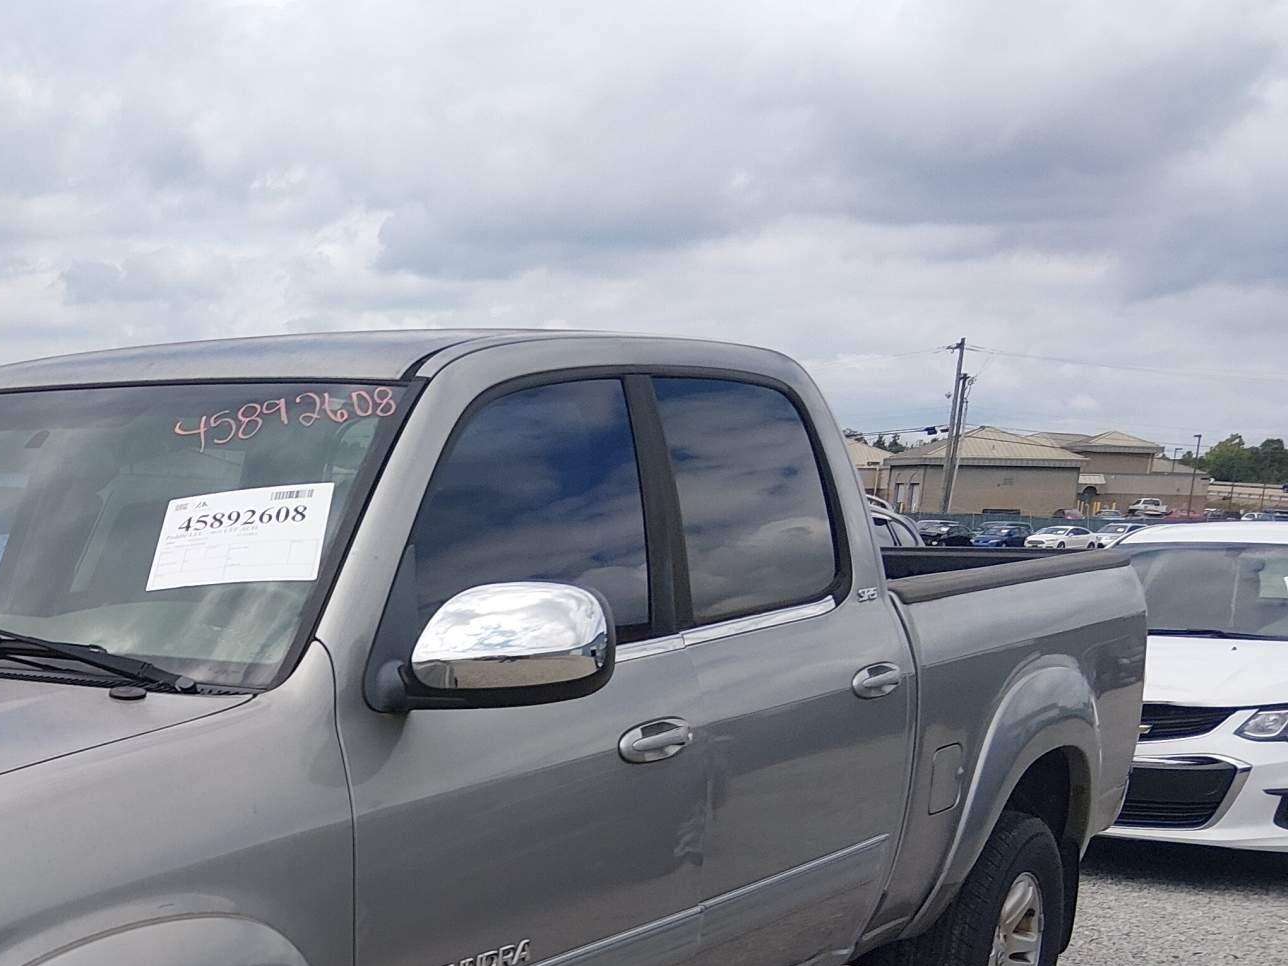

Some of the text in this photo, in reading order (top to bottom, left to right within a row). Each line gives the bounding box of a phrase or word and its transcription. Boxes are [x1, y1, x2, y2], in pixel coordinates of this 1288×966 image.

[173, 386, 397, 453] 45892608
[178, 504, 308, 533] 45892608
[857, 587, 878, 603] SR5
